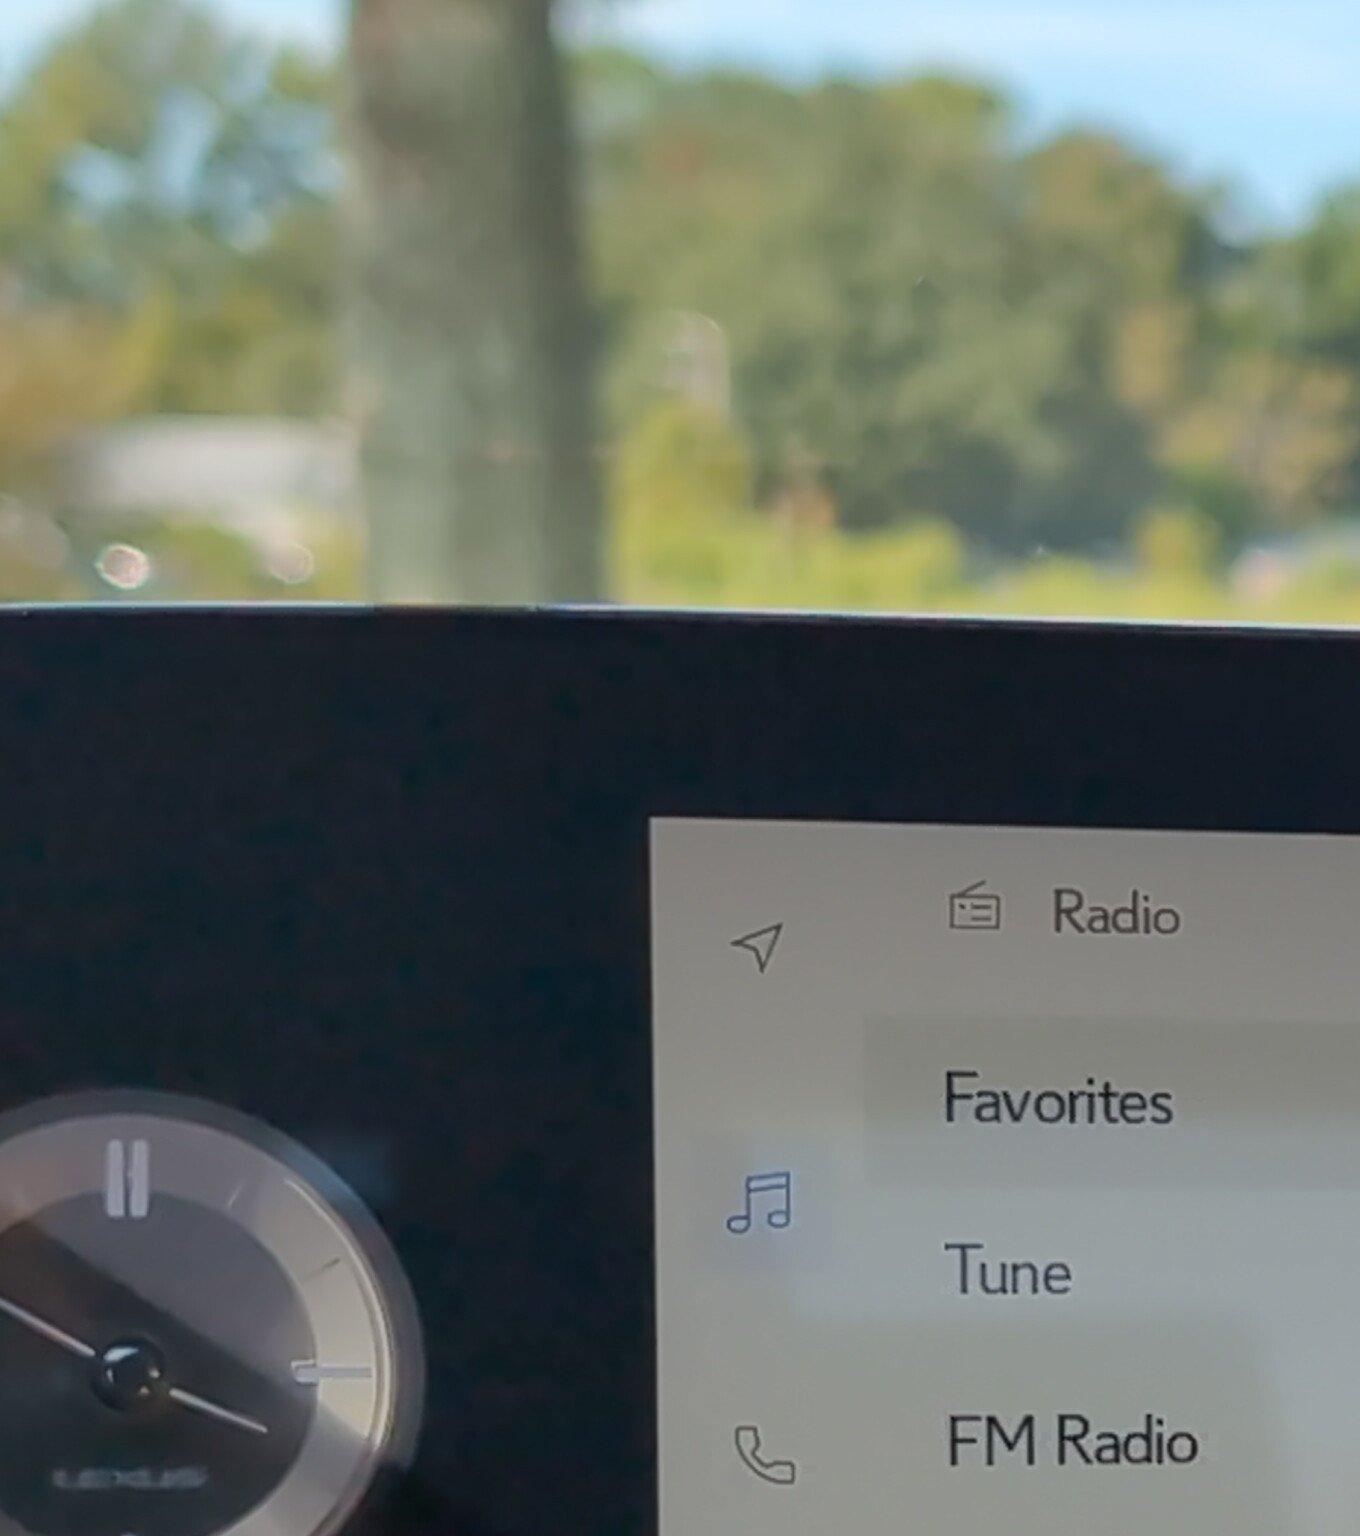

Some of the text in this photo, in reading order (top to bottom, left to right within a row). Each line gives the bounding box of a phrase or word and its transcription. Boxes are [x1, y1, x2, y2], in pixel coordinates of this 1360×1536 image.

[1053, 888, 1181, 935] Radio
[945, 1070, 1174, 1125] Favorites
[943, 1242, 1072, 1295] Tune
[949, 1413, 1199, 1467] FM Radio
